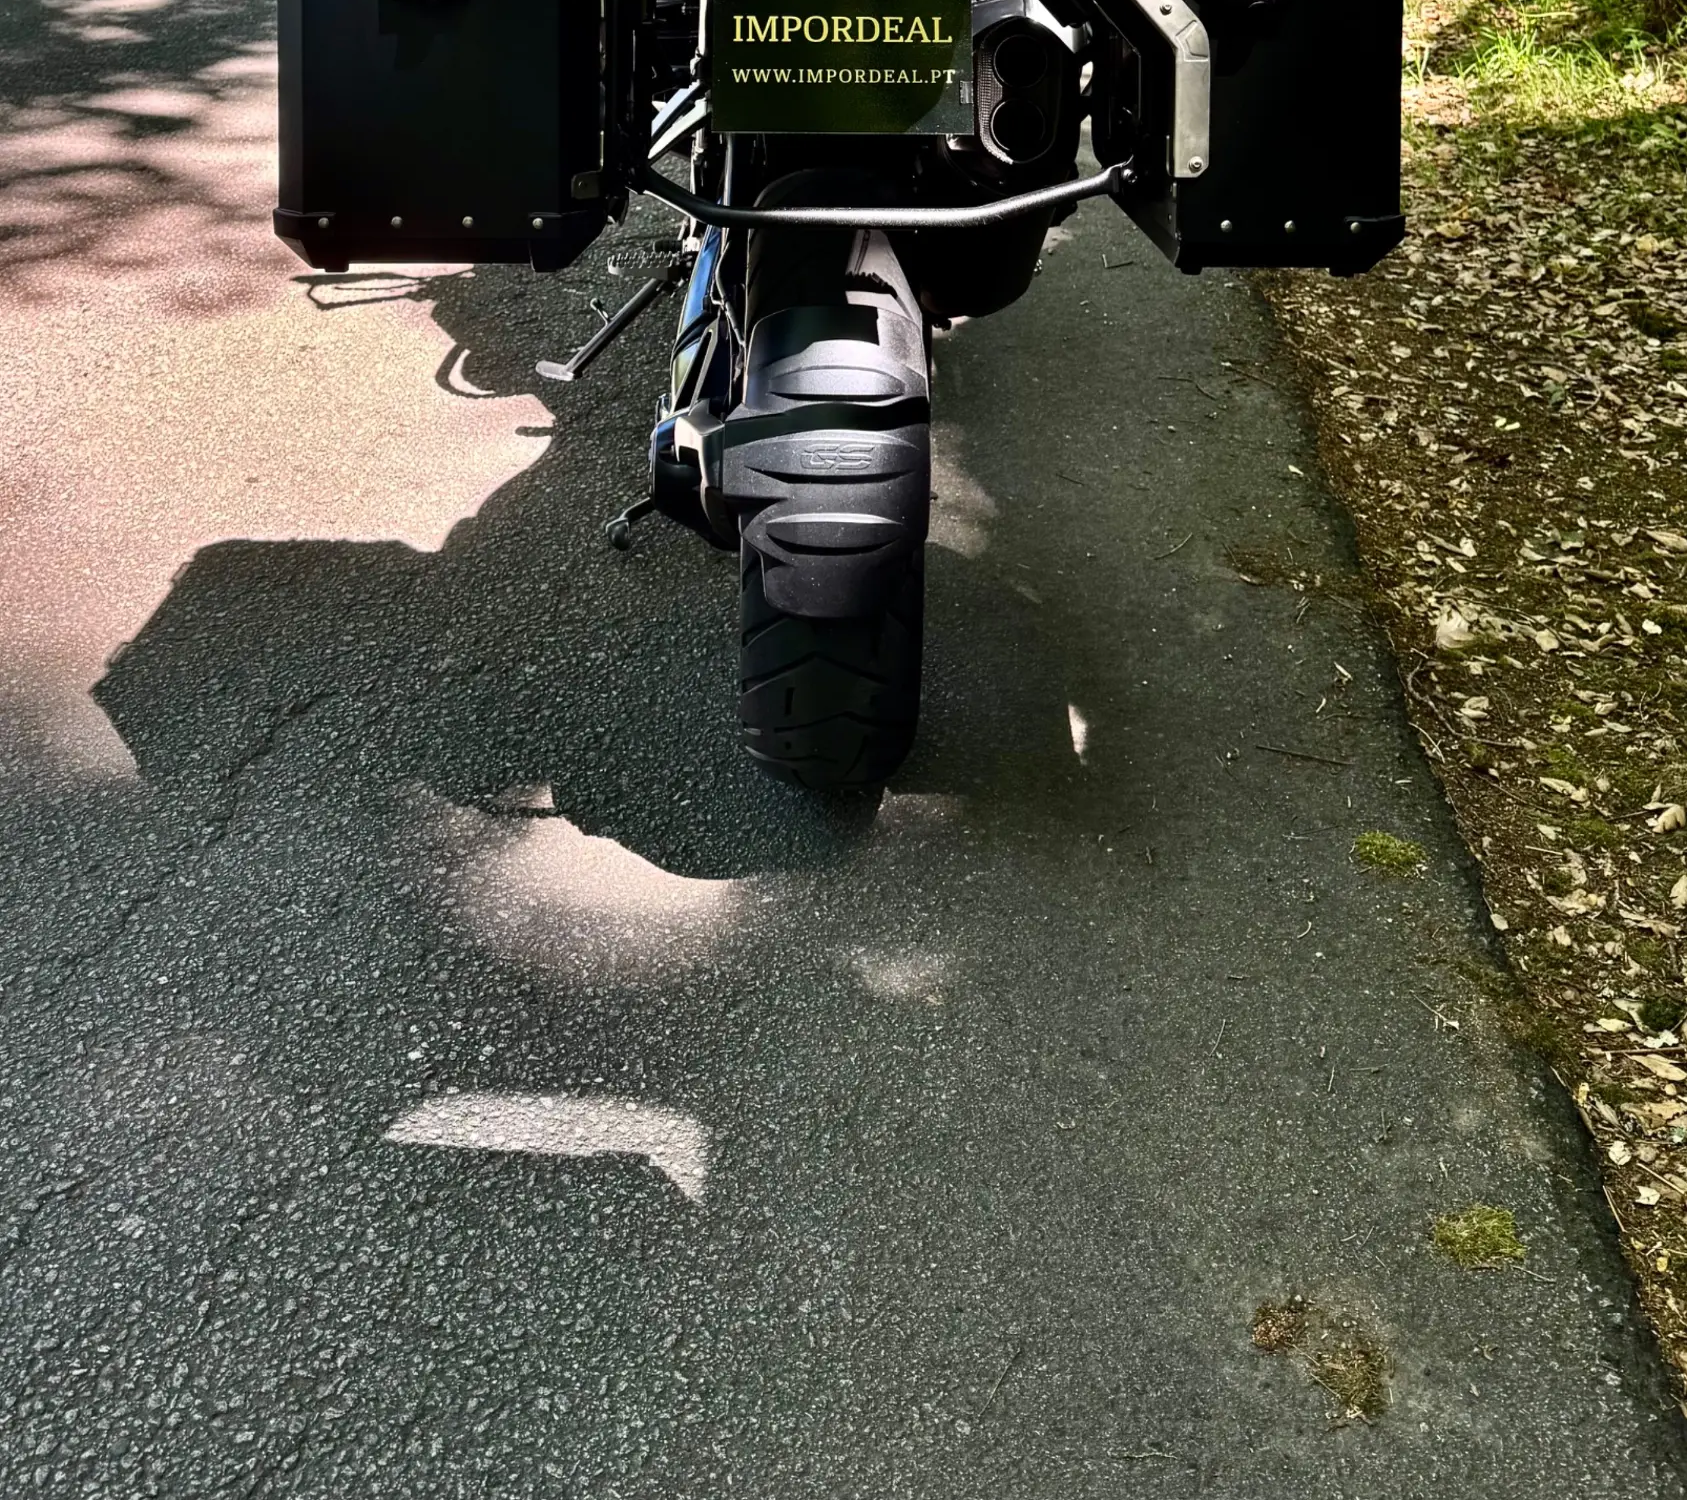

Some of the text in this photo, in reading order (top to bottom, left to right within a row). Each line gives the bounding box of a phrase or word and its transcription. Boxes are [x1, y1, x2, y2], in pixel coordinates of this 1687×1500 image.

[732, 15, 953, 43] IMPORDEAL
[731, 68, 956, 84] WWW.IMPORDEAL.PT
[801, 444, 876, 470] GS
